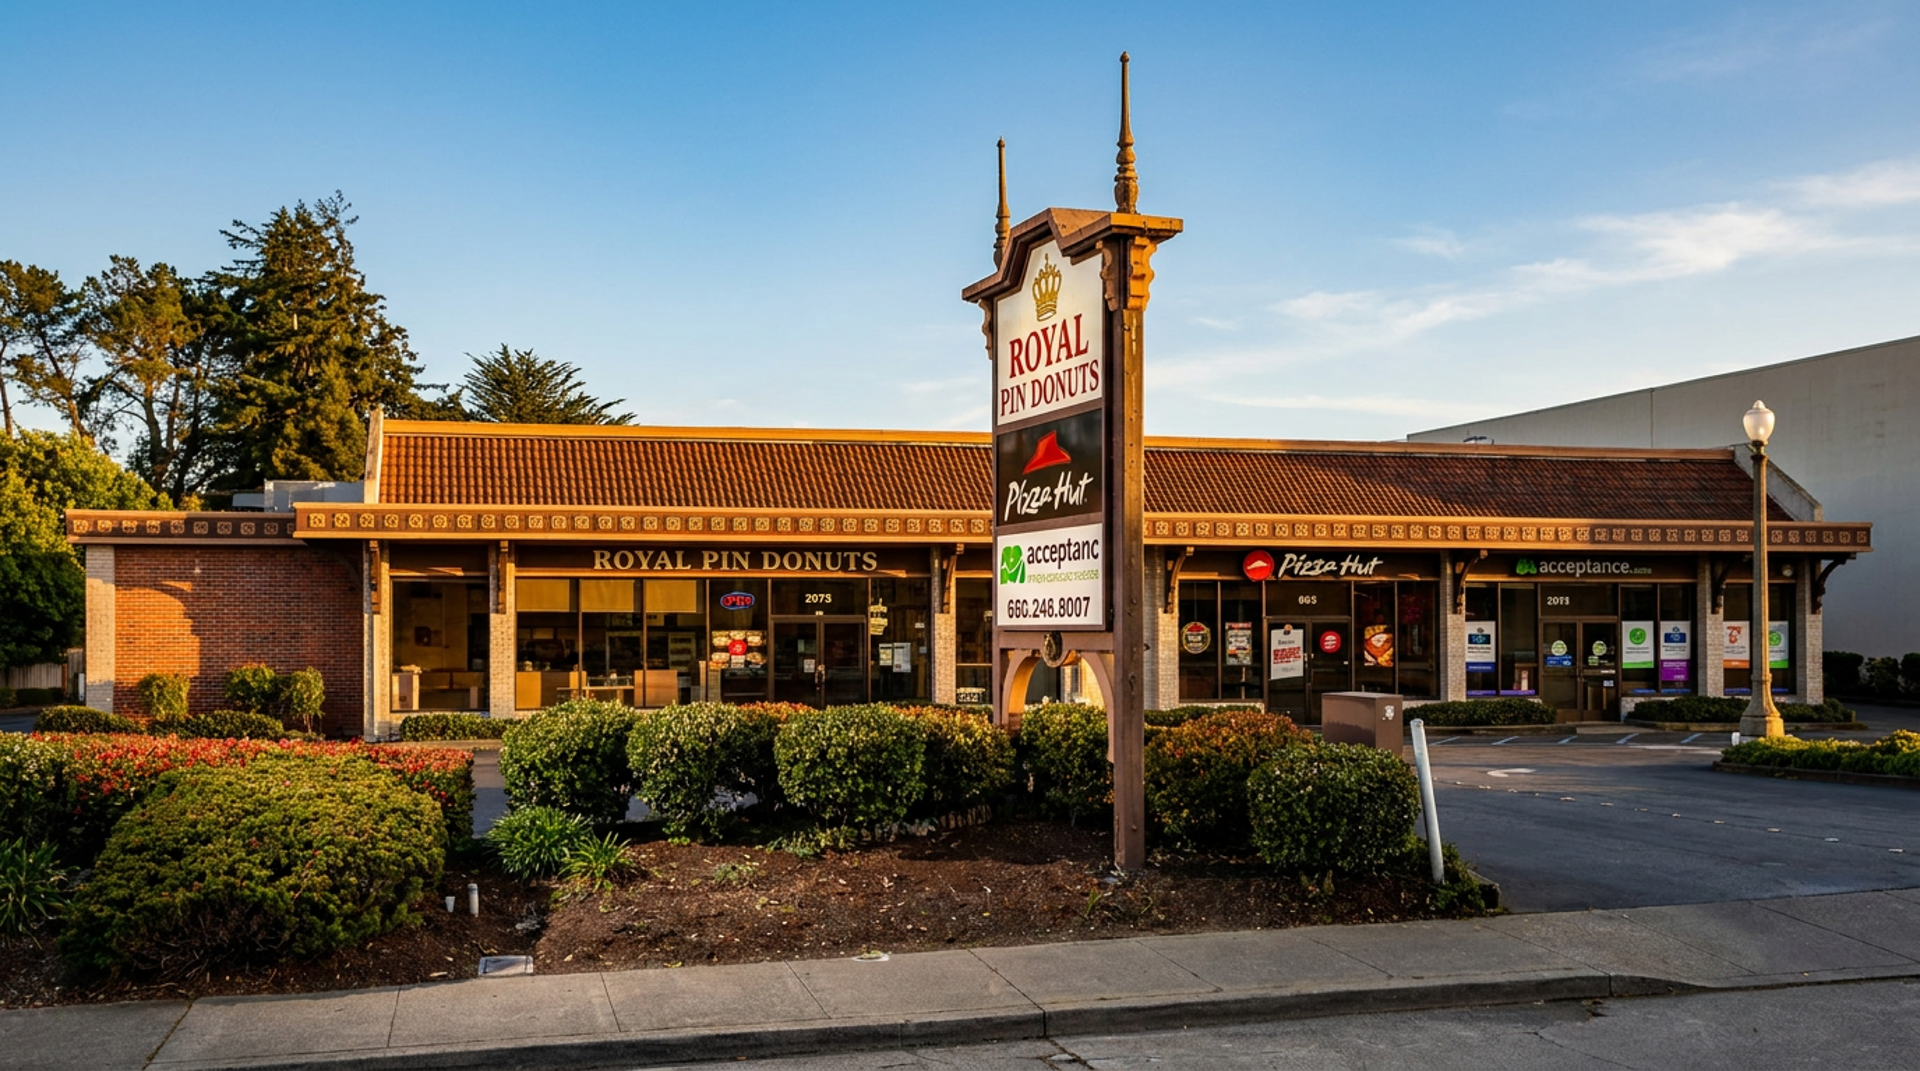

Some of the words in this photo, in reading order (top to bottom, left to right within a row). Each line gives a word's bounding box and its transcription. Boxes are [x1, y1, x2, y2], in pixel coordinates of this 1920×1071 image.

[1008, 313, 1089, 379] ROYAL
[1000, 382, 1027, 417] PIN
[1030, 359, 1100, 408] DONUTS
[1004, 479, 1053, 522] Pizza
[1053, 471, 1094, 510] Hut
[593, 550, 692, 570] ROYAL
[701, 551, 751, 570] PIN
[761, 551, 878, 571] DONUTS
[1027, 538, 1099, 569] acceptanc
[1277, 553, 1338, 578] Pizza
[1339, 554, 1384, 576] Hut
